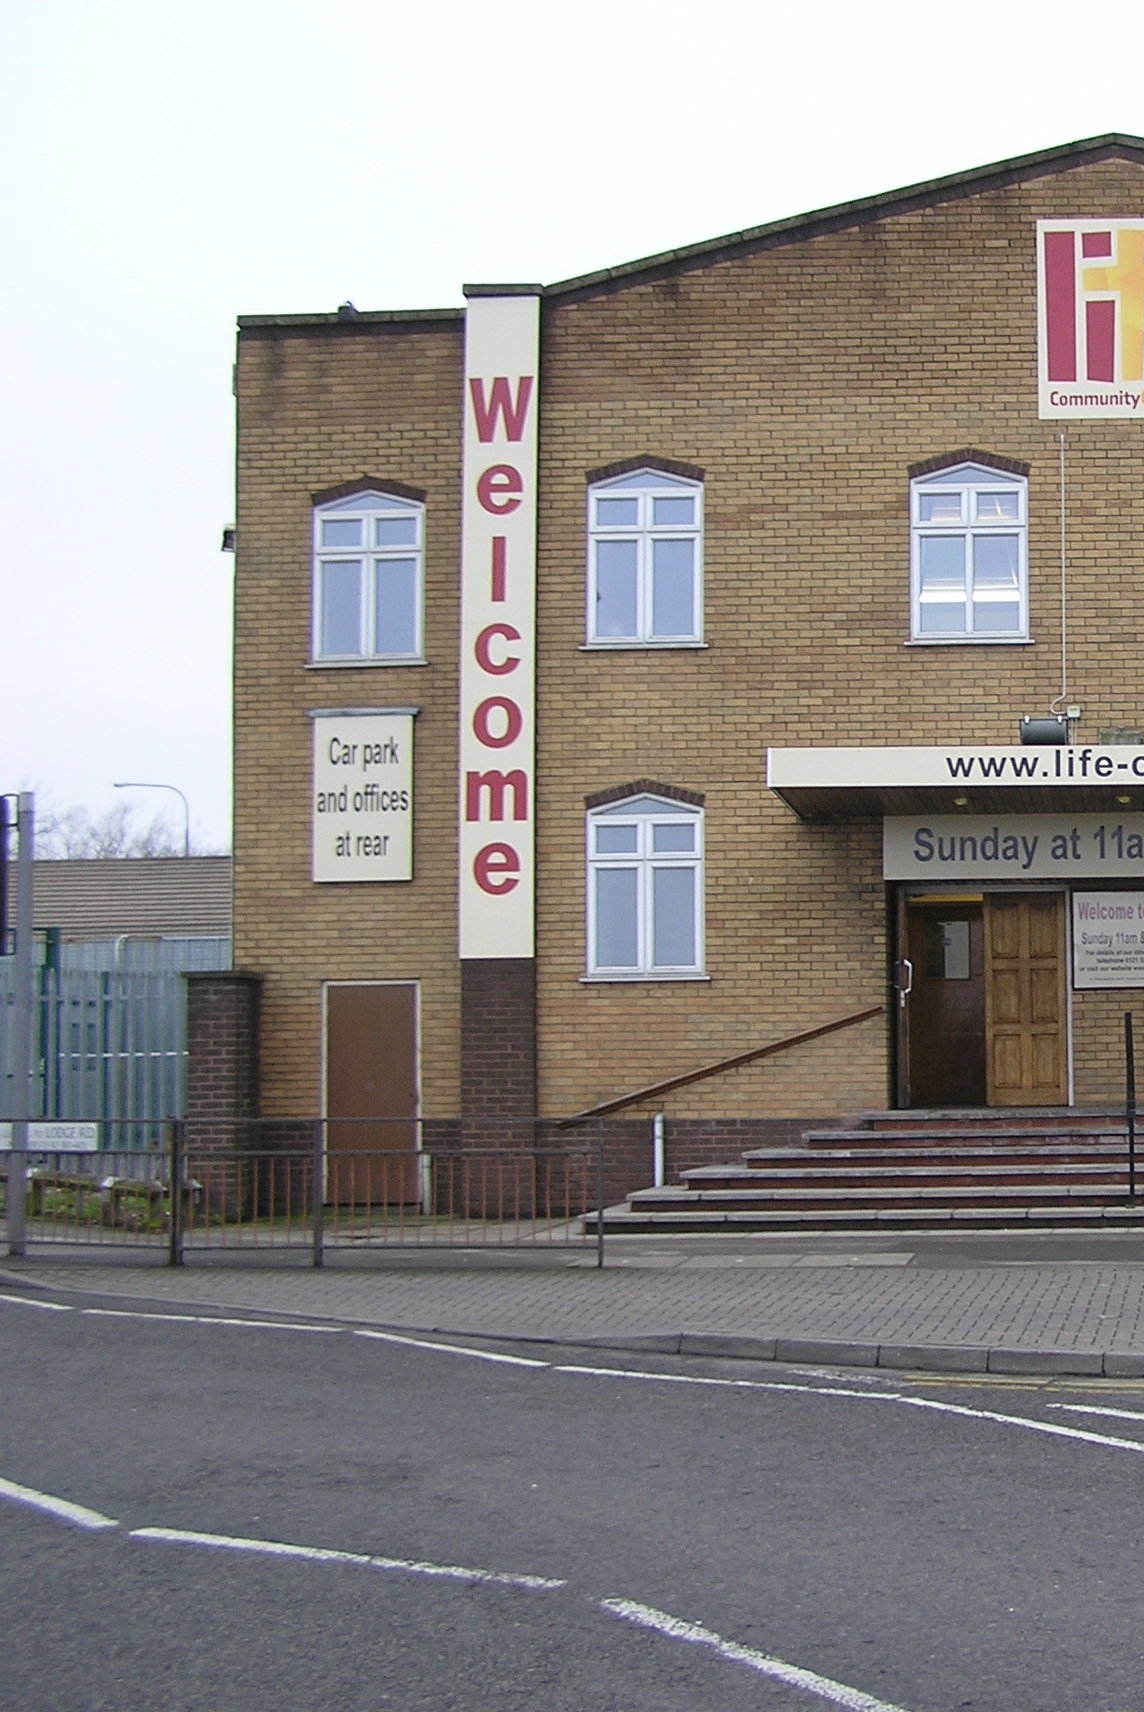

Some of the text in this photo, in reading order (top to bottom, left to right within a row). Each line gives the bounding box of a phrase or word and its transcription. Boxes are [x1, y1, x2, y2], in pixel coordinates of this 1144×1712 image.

[465, 376, 535, 896] Welcome
[329, 736, 399, 772] Car park
[317, 784, 409, 813] and offices
[336, 831, 390, 857] at rear
[914, 826, 1039, 869] Sunday
[1051, 827, 1081, 860] at
[1078, 902, 1133, 920] Welcome
[1081, 932, 1112, 947] Sunday
[1116, 932, 1138, 944] 11am
